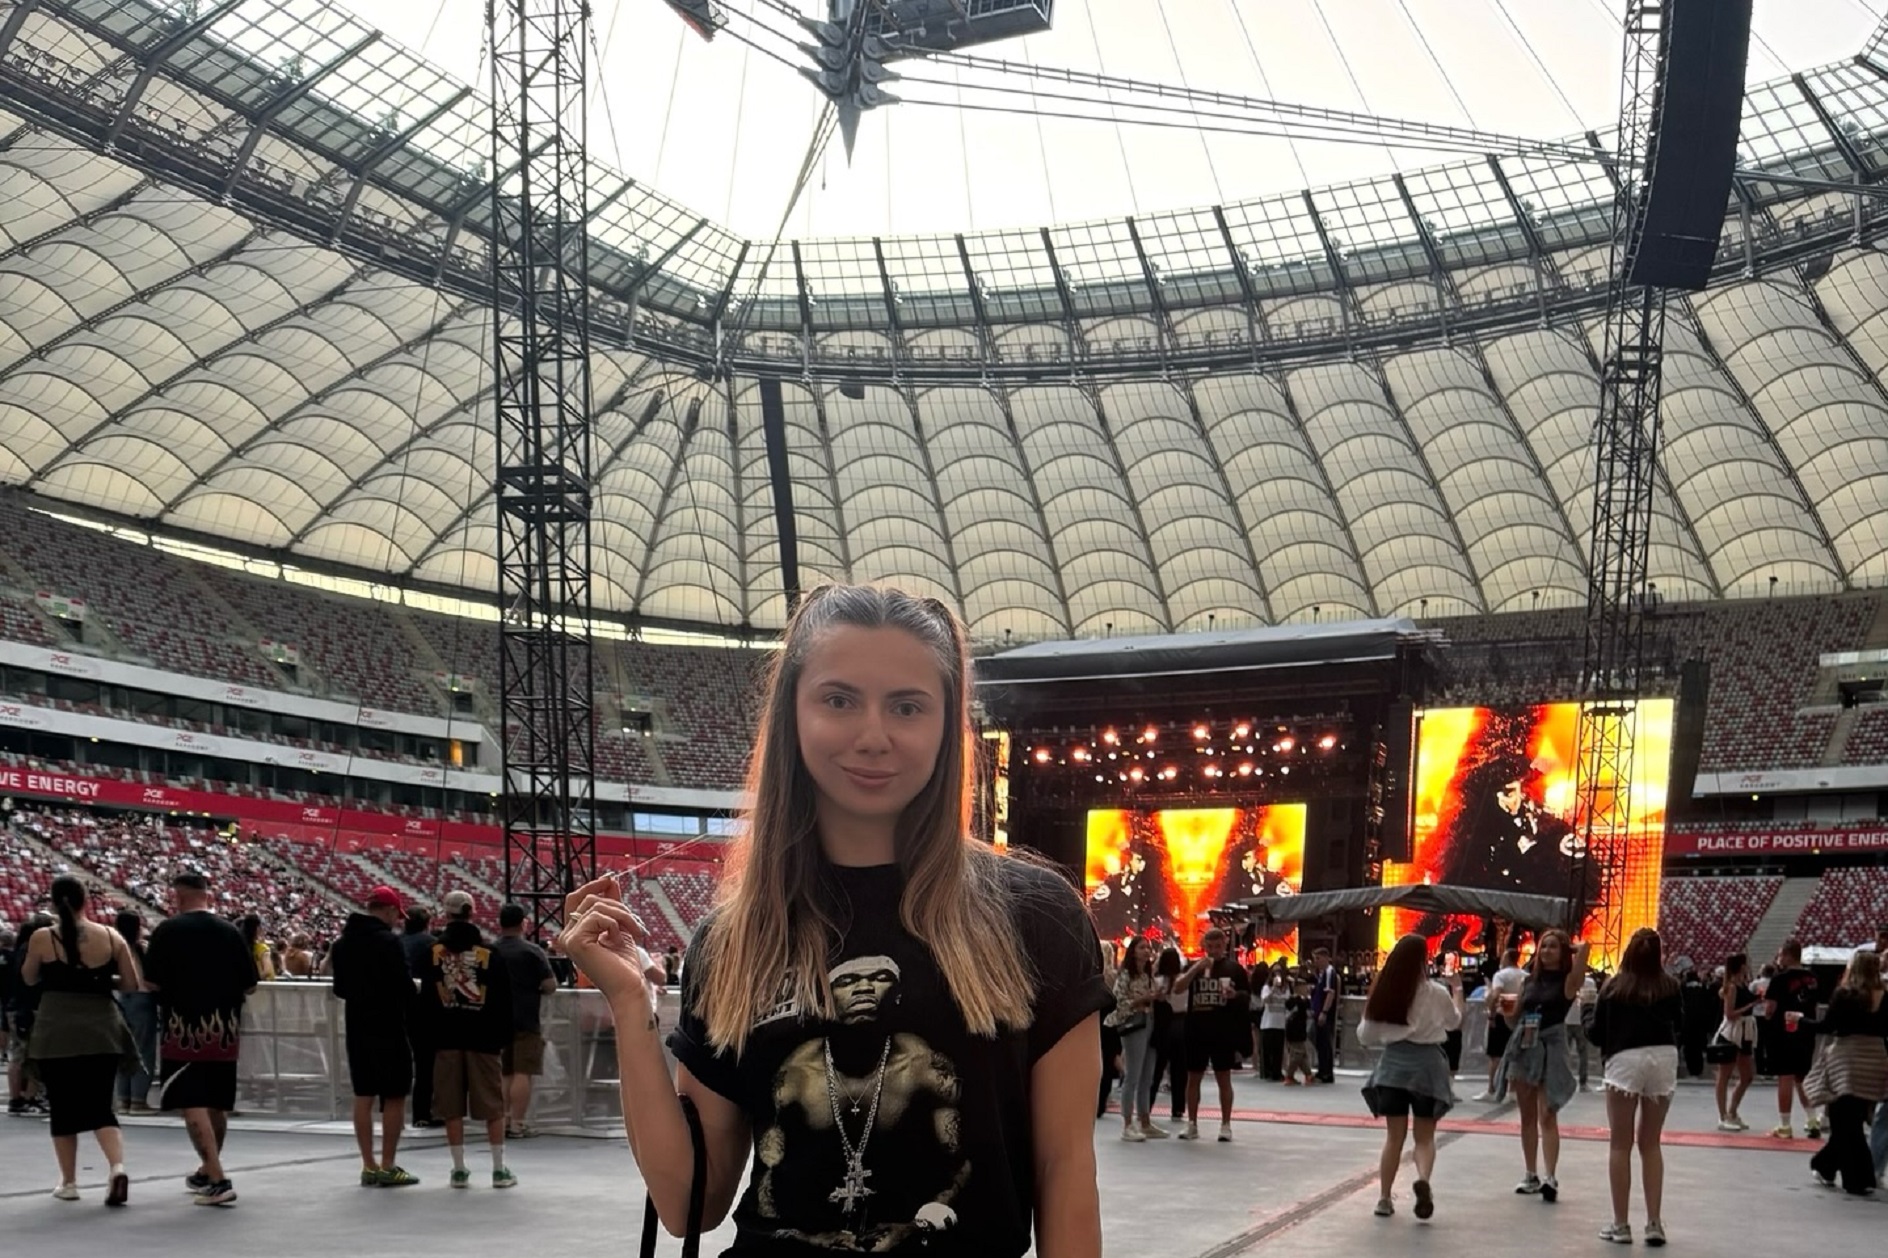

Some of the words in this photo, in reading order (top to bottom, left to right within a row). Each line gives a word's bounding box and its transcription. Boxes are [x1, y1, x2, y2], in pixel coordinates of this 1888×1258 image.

[27, 775, 100, 797] ENERGY
[1697, 837, 1745, 850] PLACE
[1748, 835, 1770, 849] OF
[1772, 834, 1844, 848] POSITIVE
